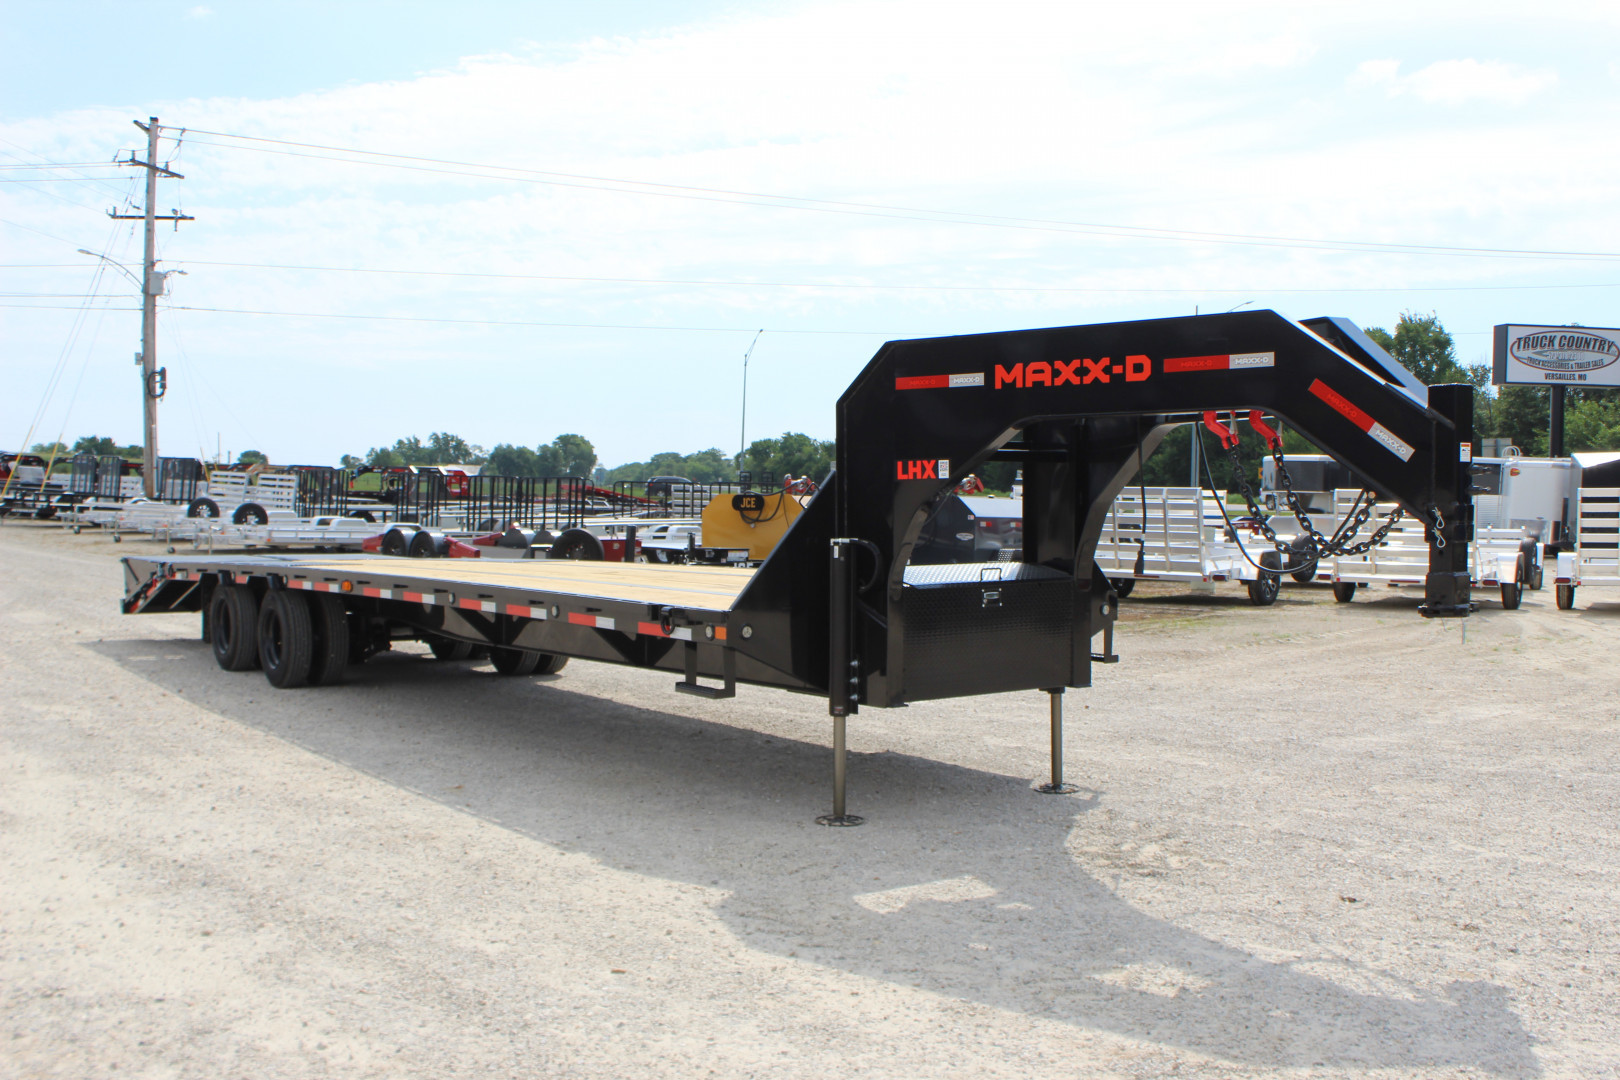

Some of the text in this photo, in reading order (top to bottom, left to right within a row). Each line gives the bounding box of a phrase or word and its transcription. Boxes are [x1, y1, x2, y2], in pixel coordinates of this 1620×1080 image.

[1516, 334, 1614, 353] TRUCK COUNTRY
[1235, 356, 1268, 364] MAXX-D
[1526, 356, 1541, 366] TRUCK
[1541, 359, 1570, 370] ACCESSORIES
[1574, 361, 1591, 369] TRAILER
[1591, 358, 1604, 368] SALES
[994, 354, 1152, 390] MAXX-D
[1577, 373, 1587, 381] MO
[1375, 429, 1407, 455] MAXX-D
[897, 459, 936, 480] LHX
[740, 498, 756, 508] JCE
